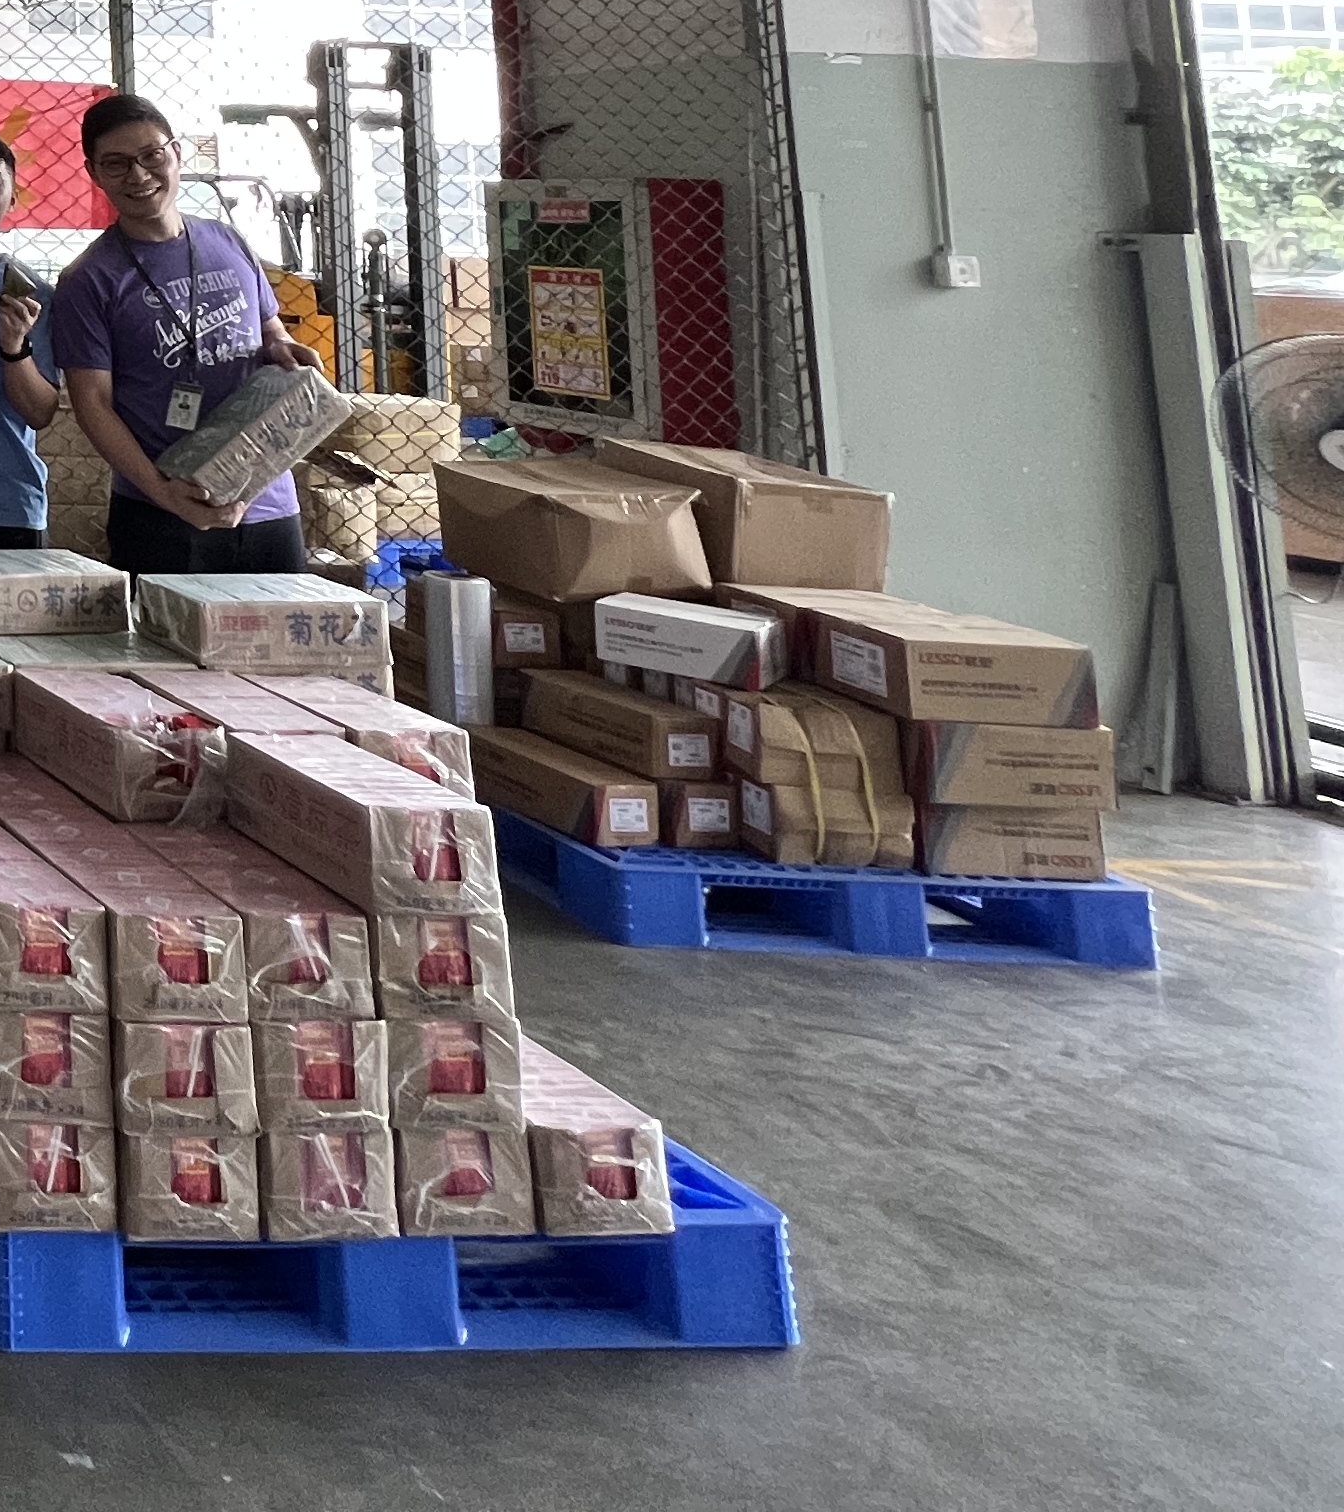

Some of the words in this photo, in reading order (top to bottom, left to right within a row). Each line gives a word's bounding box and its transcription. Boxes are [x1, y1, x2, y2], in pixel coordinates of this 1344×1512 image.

[167, 269, 241, 300] TUGHING
[41, 583, 122, 617] 菊花茶
